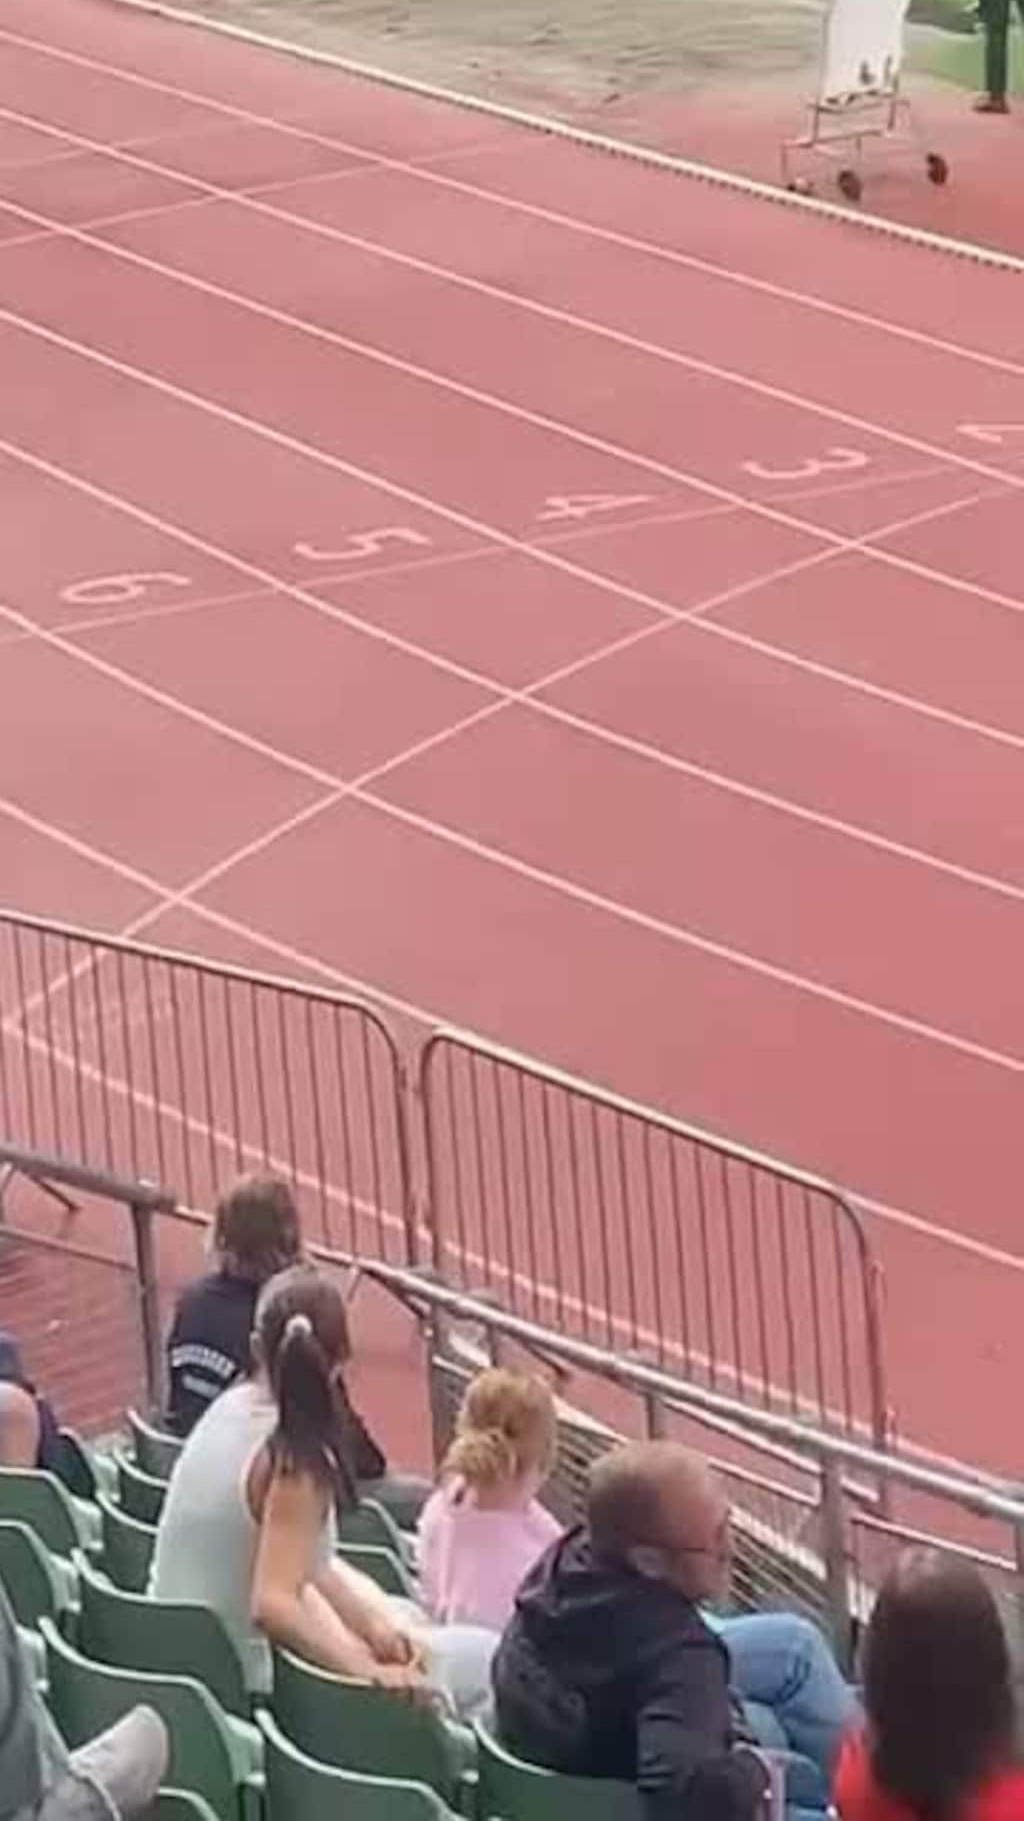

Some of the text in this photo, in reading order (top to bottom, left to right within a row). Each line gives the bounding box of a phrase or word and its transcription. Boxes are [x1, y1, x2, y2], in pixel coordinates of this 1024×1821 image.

[741, 446, 870, 481] 3
[536, 493, 658, 522] 4
[293, 527, 432, 561] 5
[59, 571, 191, 605] 6
